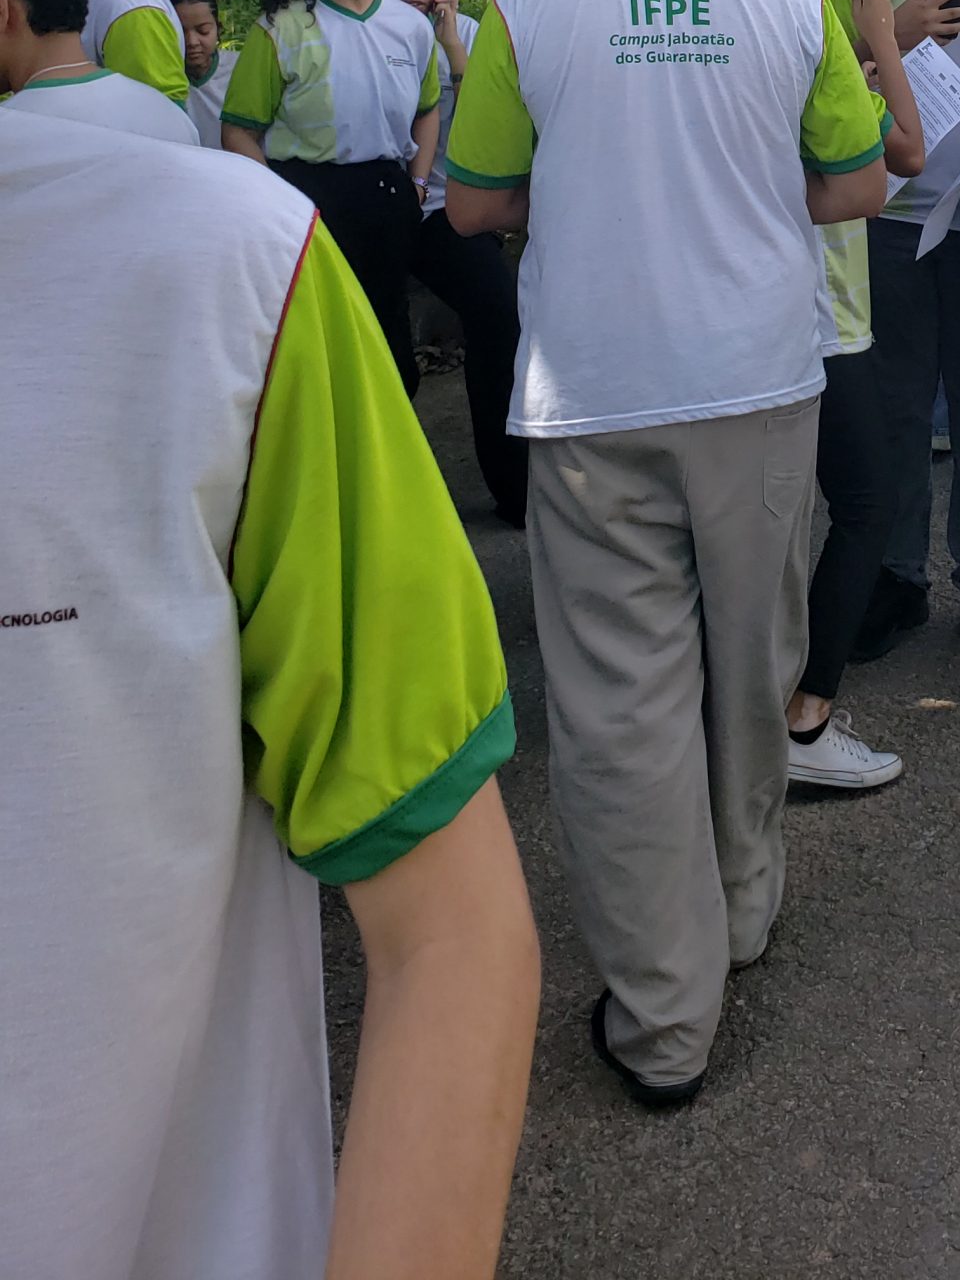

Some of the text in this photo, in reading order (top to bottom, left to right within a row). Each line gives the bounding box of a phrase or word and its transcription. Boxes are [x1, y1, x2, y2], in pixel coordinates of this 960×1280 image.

[609, 31, 735, 48] Campus Jaboatão
[615, 51, 730, 66] dos Guararapes
[0, 607, 78, 628] CNOLOGIA
